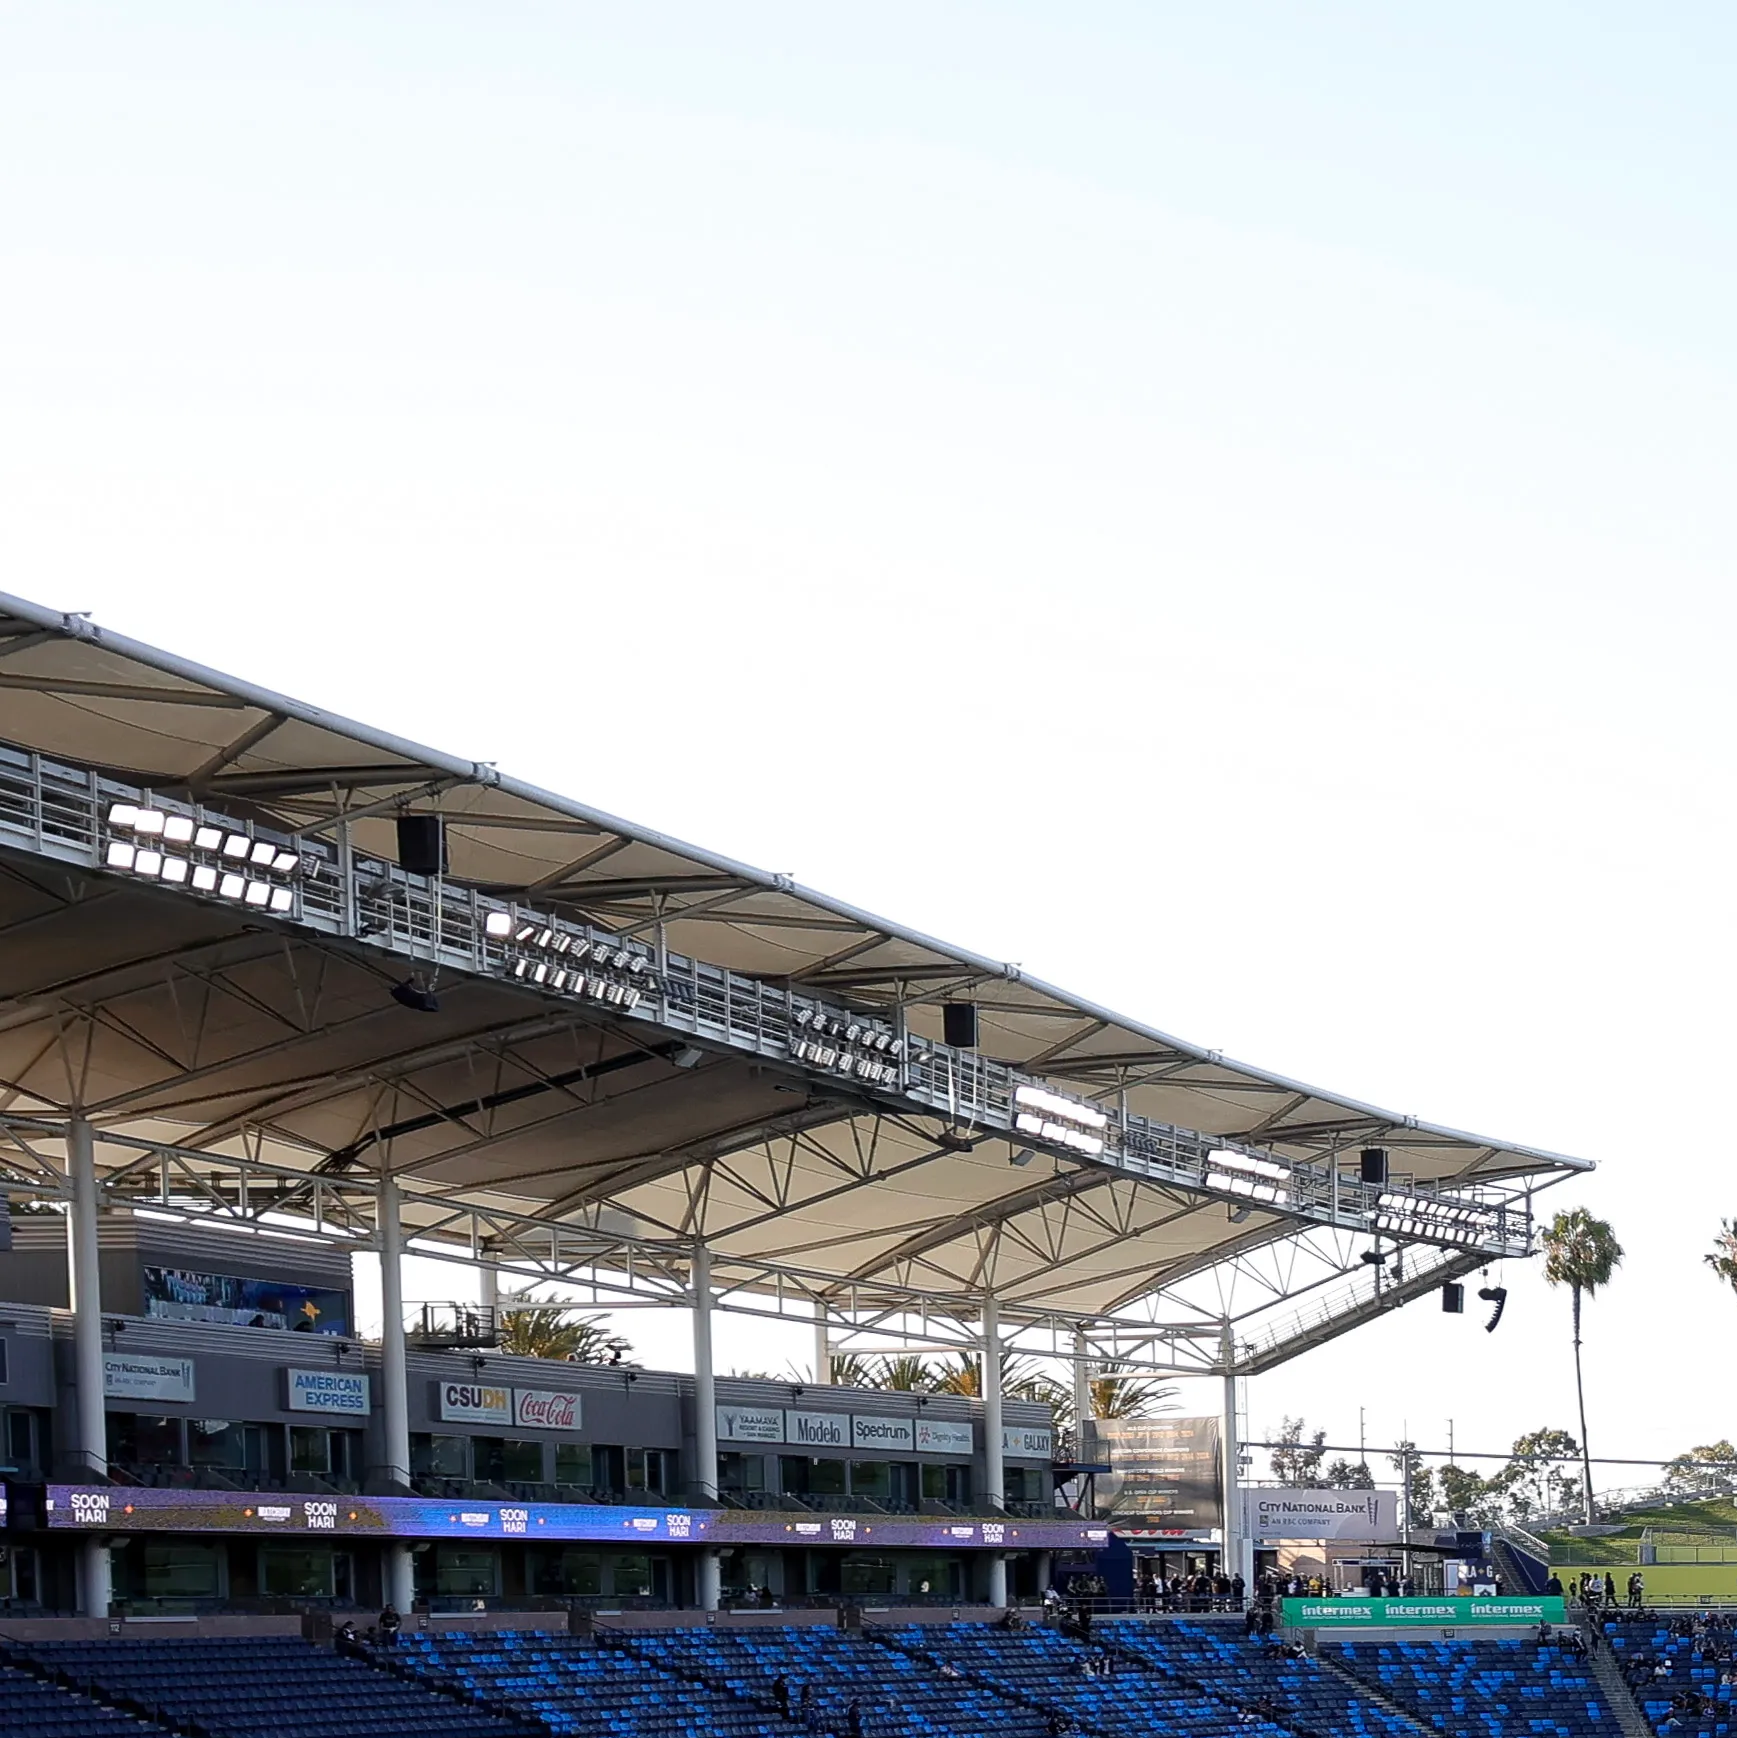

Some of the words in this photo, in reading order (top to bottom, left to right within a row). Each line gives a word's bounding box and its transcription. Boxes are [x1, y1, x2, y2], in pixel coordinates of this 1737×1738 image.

[295, 1374, 362, 1393] AMERICAN
[305, 1391, 364, 1408] EXPRESS
[446, 1385, 507, 1410] CSUDH
[797, 1418, 840, 1443] Modelo
[856, 1421, 906, 1440] Spectrum
[1024, 1434, 1050, 1451] GALAXY
[71, 1494, 109, 1509] SOON
[1259, 1502, 1281, 1512] CITY
[1282, 1502, 1335, 1513] NATIONAL
[1336, 1503, 1366, 1513] BANK
[304, 1502, 337, 1516] SOON
[500, 1509, 528, 1522] SOON
[75, 1509, 107, 1523] HARI
[308, 1516, 335, 1528] HARI
[667, 1514, 691, 1527] SOON
[503, 1521, 526, 1533] HARI
[669, 1525, 689, 1537] HARI
[831, 1519, 856, 1531] SOON
[834, 1529, 854, 1541] HARI
[1302, 1604, 1373, 1616] intermex
[1385, 1603, 1456, 1615] intermex
[1470, 1603, 1544, 1614] intermex
